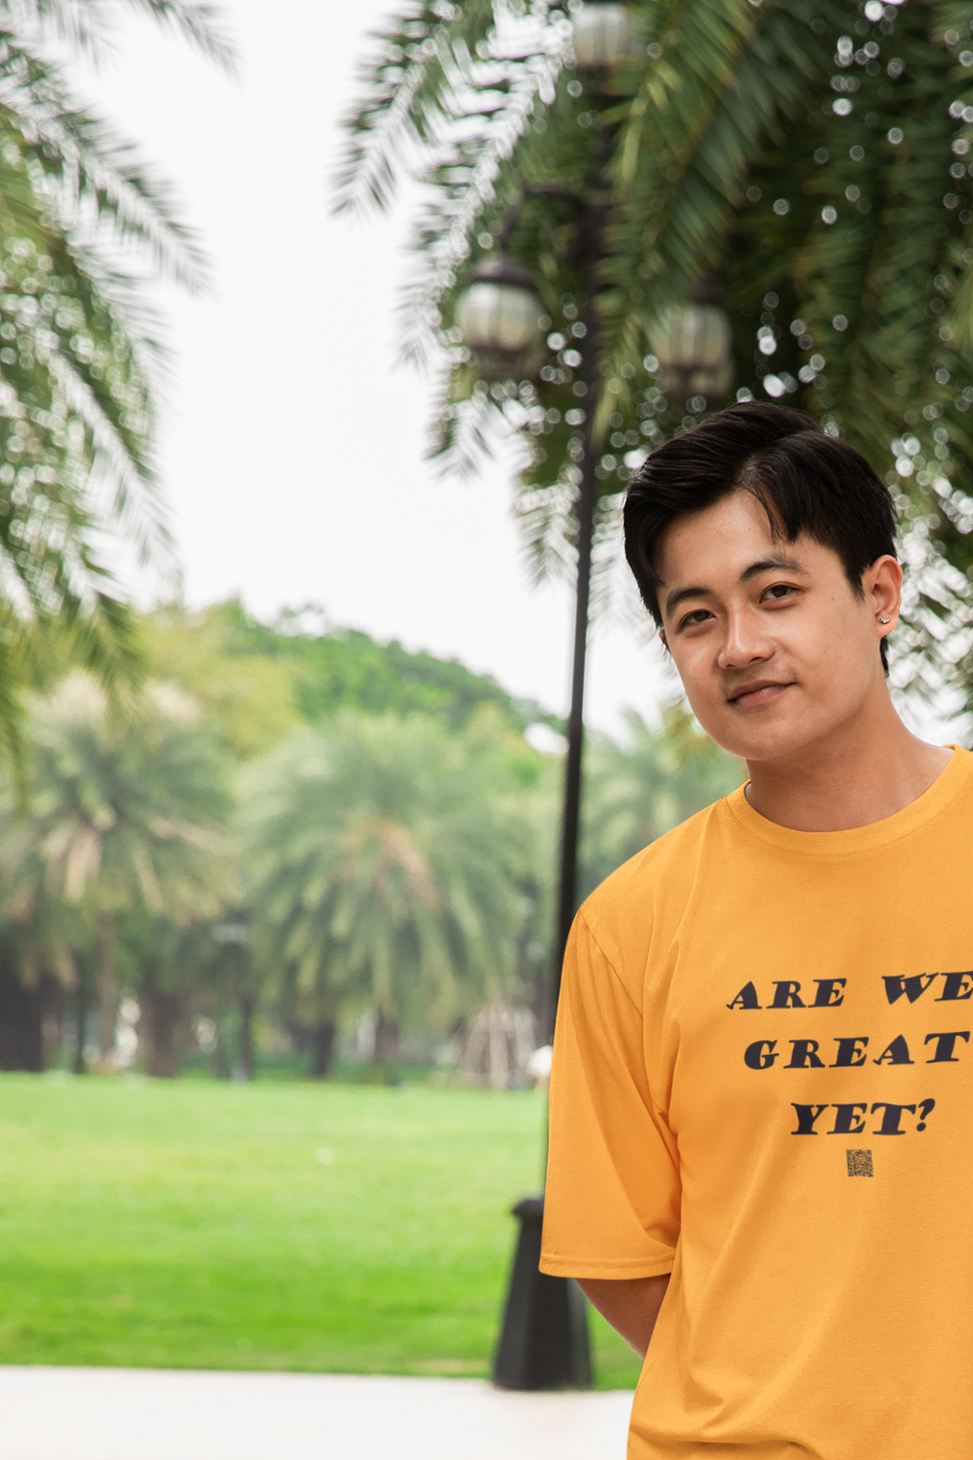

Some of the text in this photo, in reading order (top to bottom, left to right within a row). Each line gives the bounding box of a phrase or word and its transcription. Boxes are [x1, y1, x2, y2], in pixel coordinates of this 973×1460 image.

[726, 978, 847, 1010] ARE
[743, 1031, 971, 1070] GREAT
[790, 1098, 936, 1136] YET?
